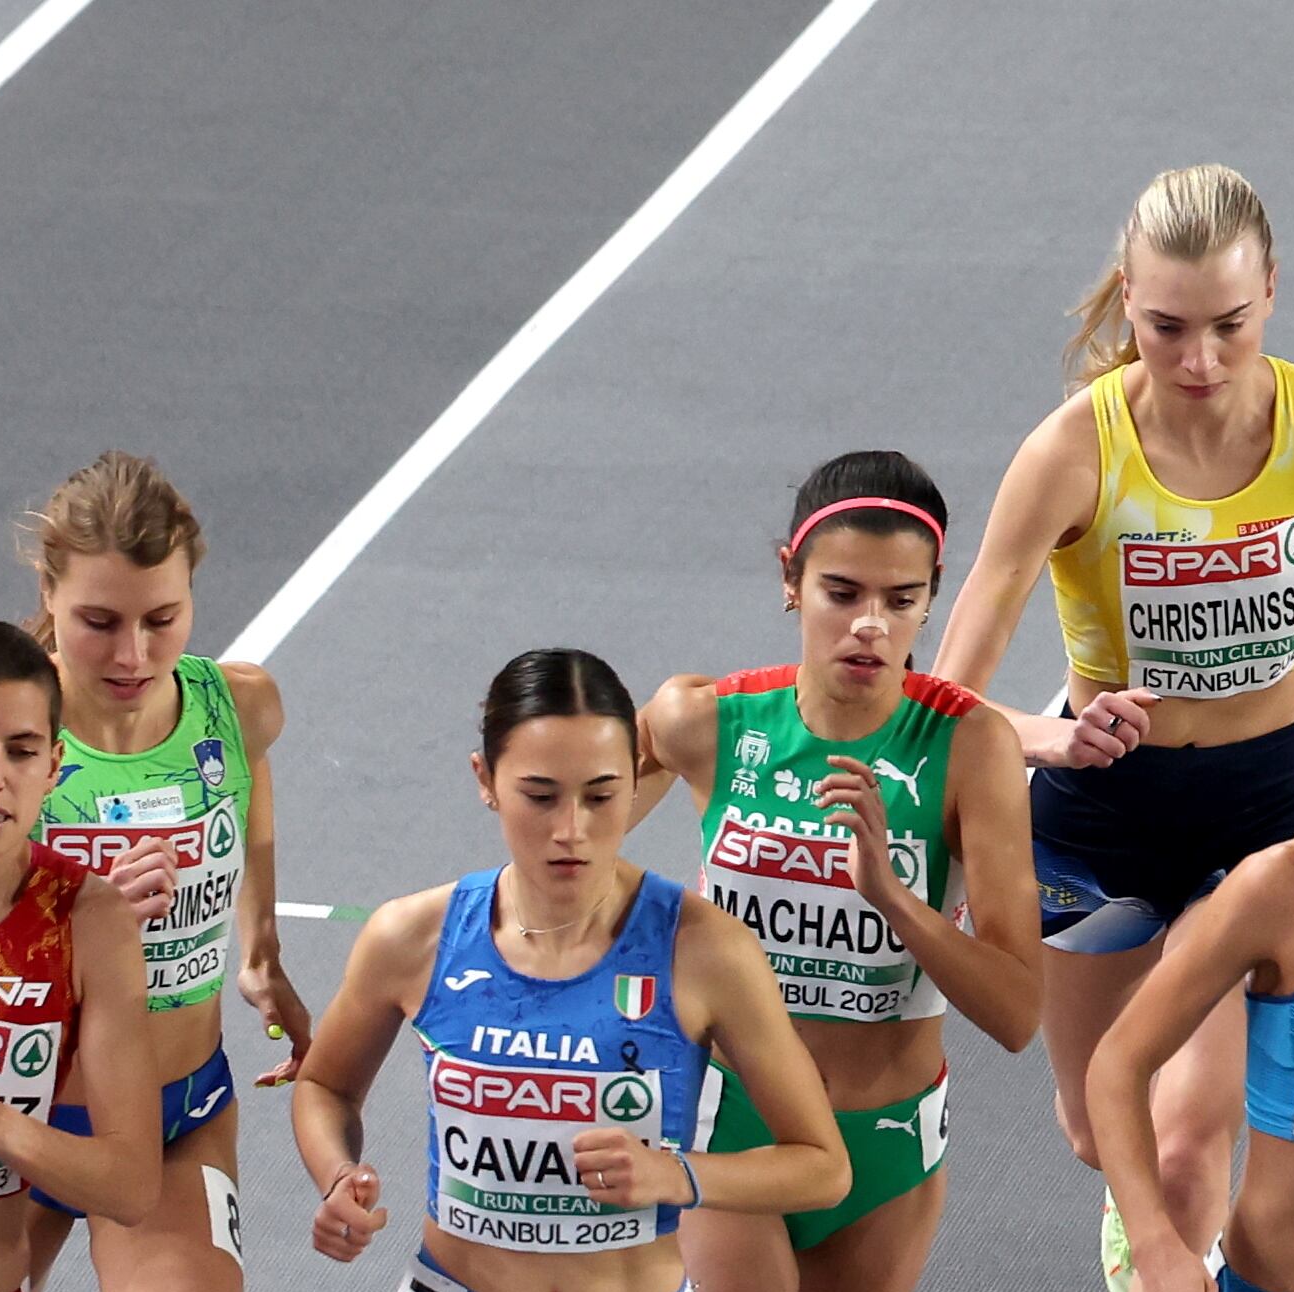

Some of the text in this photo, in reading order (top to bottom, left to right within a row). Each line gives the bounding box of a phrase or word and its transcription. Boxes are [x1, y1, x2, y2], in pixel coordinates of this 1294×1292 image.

[1128, 541, 1278, 581] SPAR
[1172, 639, 1290, 667] I RUN CLEAN
[1142, 667, 1264, 692] ISTANBUL
[731, 778, 757, 798] FPA
[51, 830, 202, 869] SPR
[176, 948, 220, 987] 2023
[800, 960, 866, 982] CLEAN
[840, 990, 900, 1014] 2023
[471, 1026, 600, 1064] ITALIA
[437, 1068, 593, 1117] SPAR
[474, 1190, 601, 1214] I RUN CLEAN
[449, 1205, 640, 1245] ISTANBUL 2023
